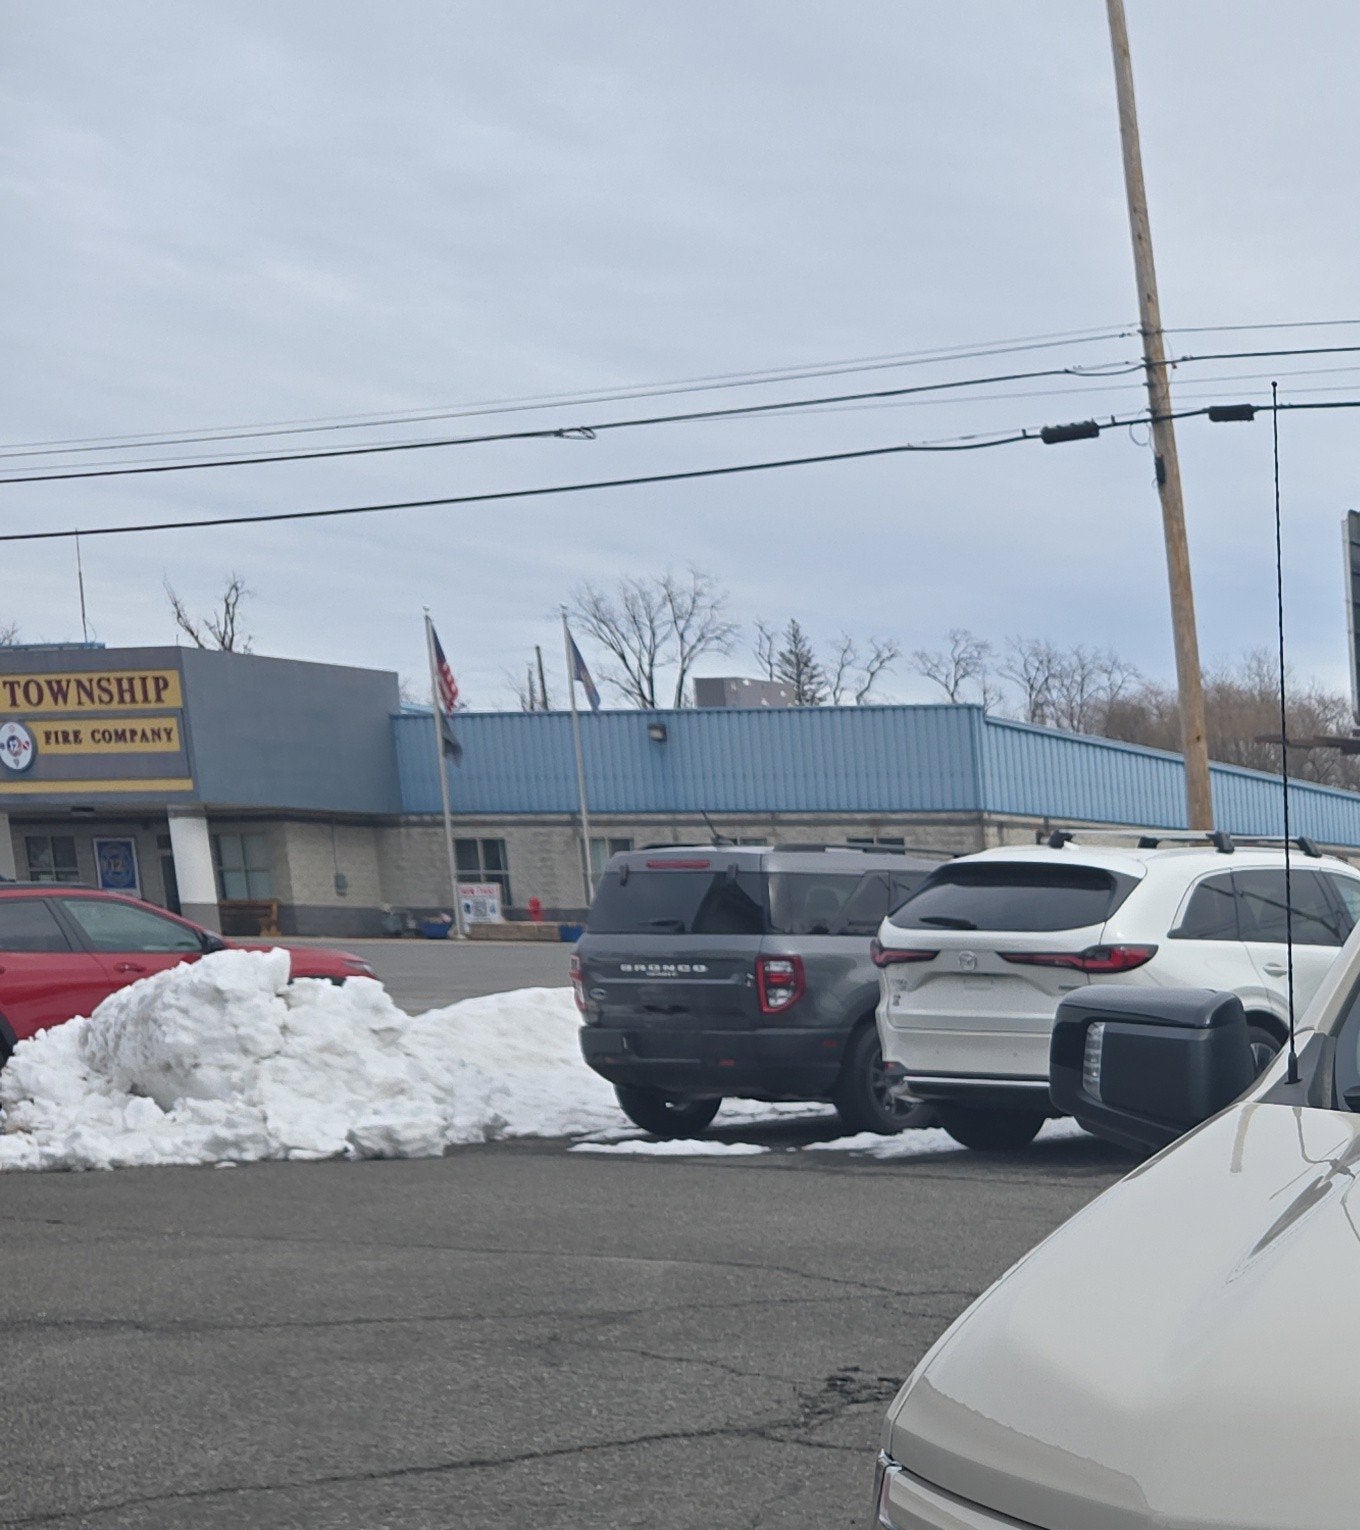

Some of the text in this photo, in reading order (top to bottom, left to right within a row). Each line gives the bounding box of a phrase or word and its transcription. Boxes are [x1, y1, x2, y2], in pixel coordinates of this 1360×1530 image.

[2, 675, 169, 708] TOWNSHIP
[43, 727, 173, 746] FIRE COMPANY
[620, 963, 708, 973] BRONCO
